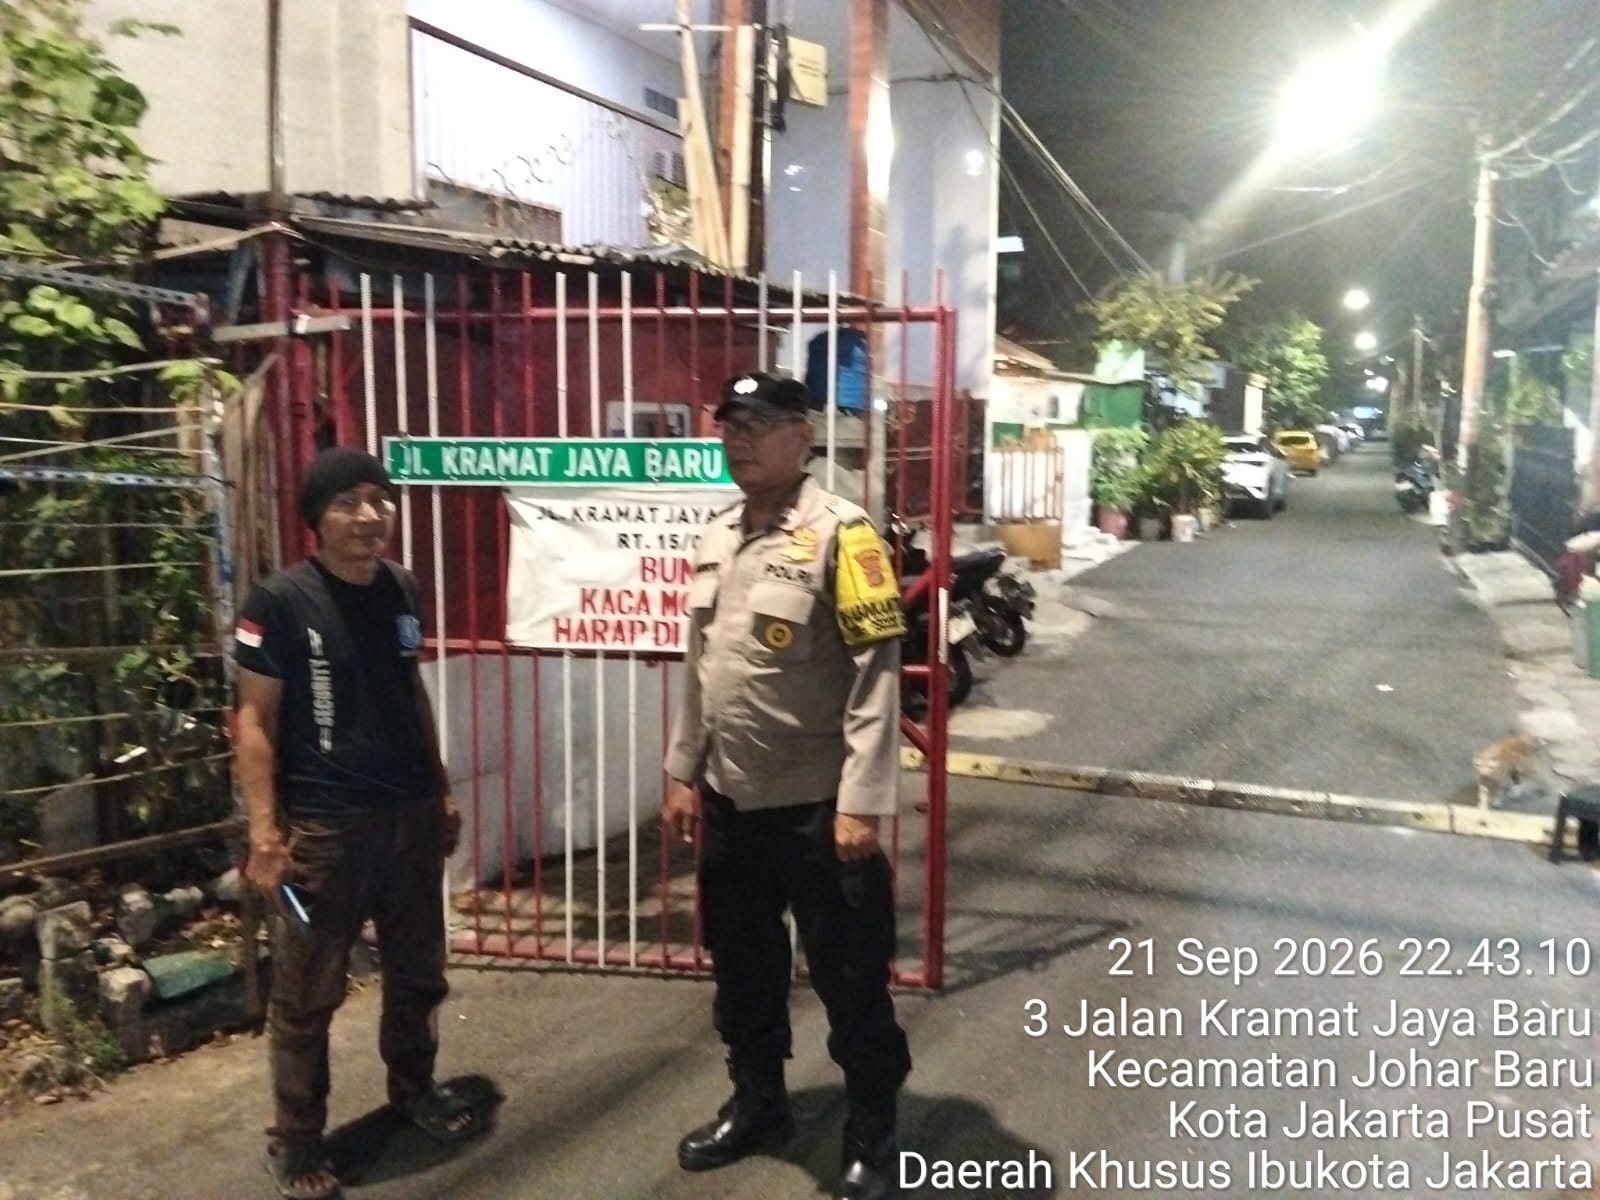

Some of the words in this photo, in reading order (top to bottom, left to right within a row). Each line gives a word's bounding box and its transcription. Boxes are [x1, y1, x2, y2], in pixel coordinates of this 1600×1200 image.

[441, 446, 552, 477] KRAMAT
[563, 447, 632, 478] JAYA
[644, 447, 723, 480] BARU
[572, 505, 659, 523] KRAMAT
[617, 532, 651, 549] RT.
[554, 618, 647, 646] HARAP
[654, 620, 681, 648] DI
[308, 658, 335, 727] SECURITY
